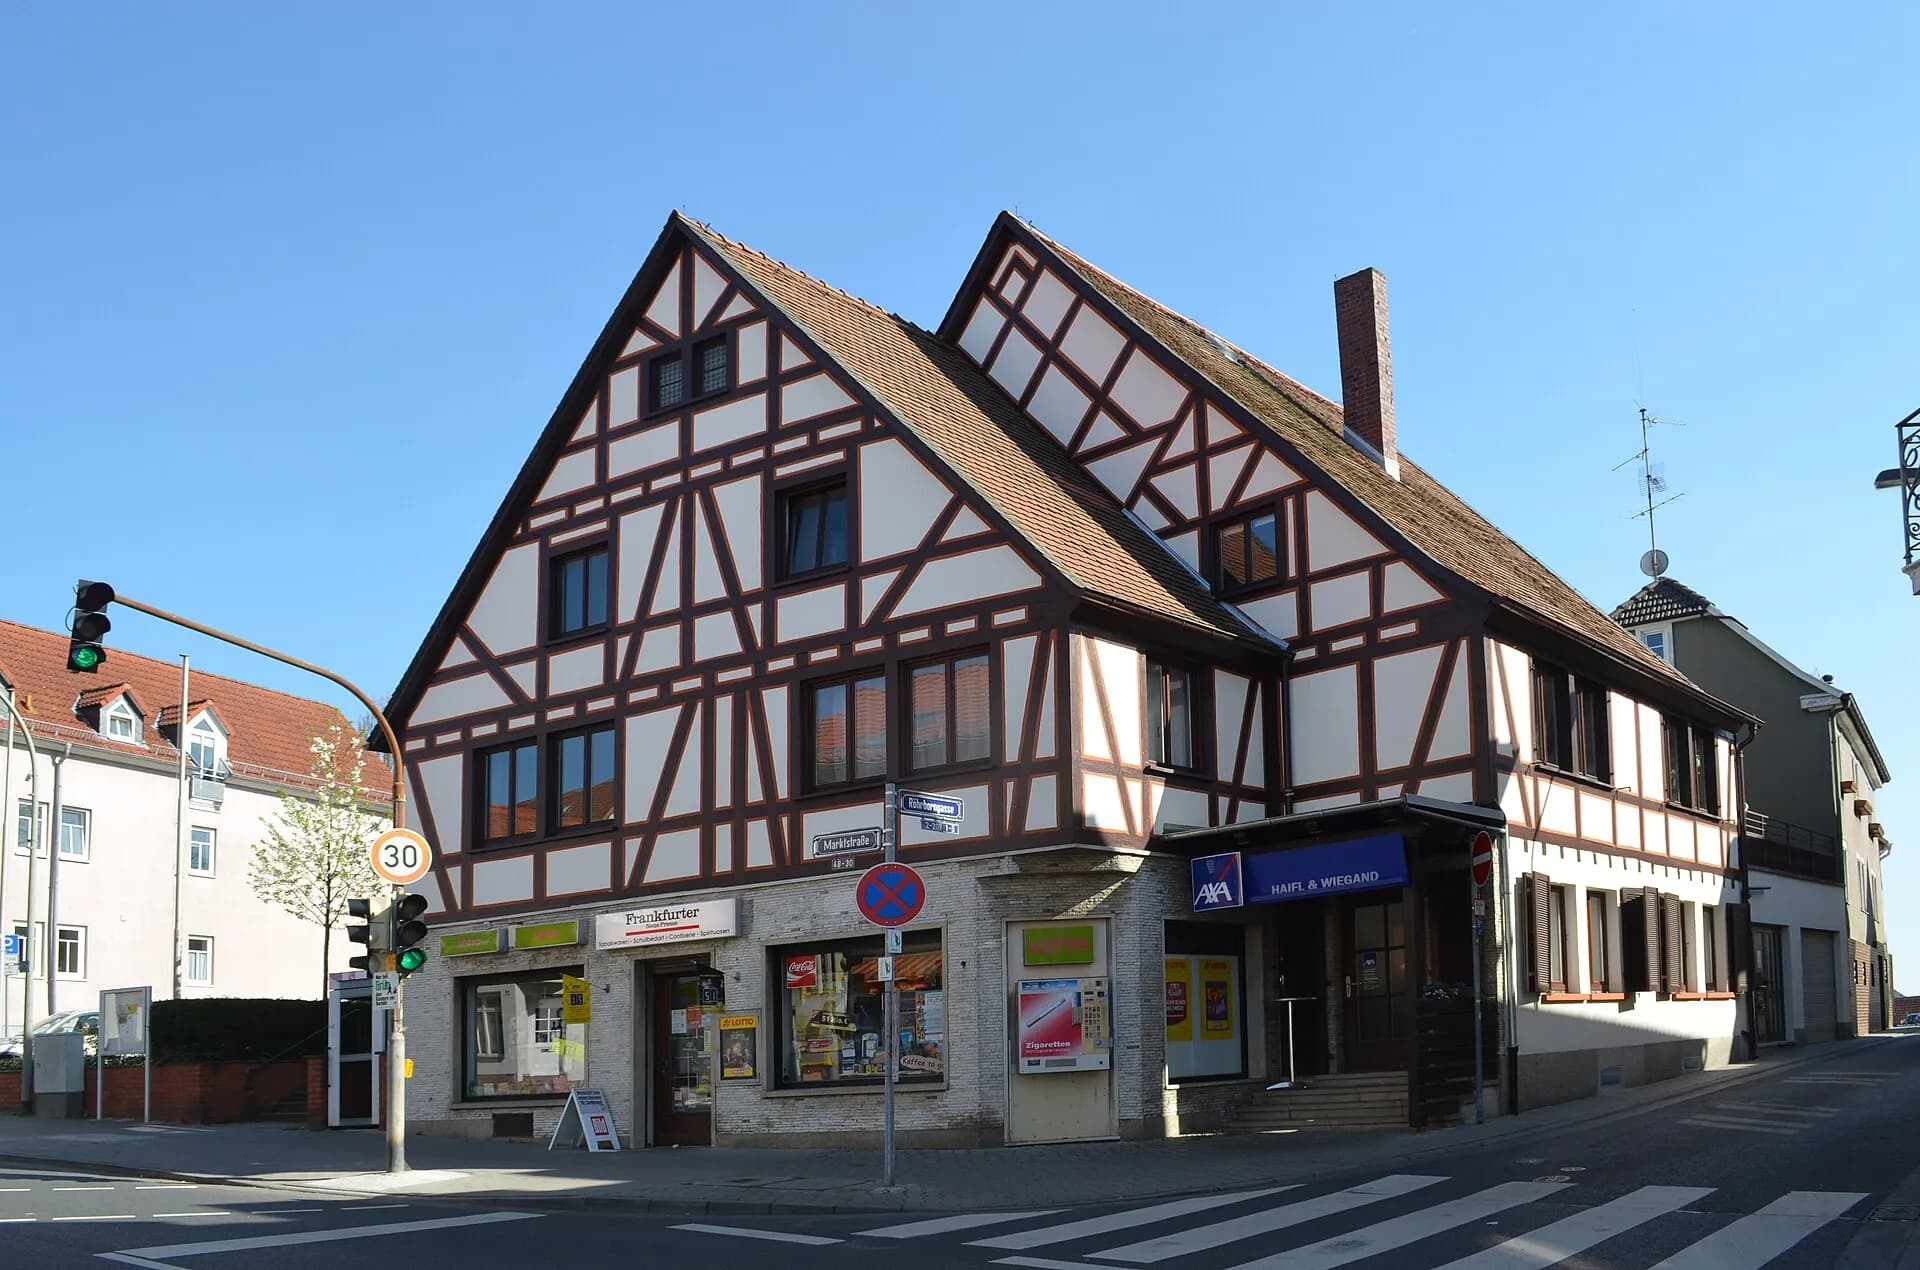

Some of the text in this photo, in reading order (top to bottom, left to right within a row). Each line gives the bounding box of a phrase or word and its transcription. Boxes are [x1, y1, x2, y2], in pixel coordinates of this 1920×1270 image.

[823, 834, 870, 851] Marktstraße
[384, 845, 417, 868] 30
[1271, 871, 1380, 895] HAIFL & WIEGAND
[1194, 881, 1233, 905] AXA
[625, 907, 700, 926] Frankfurter
[731, 1018, 754, 1026] LOTTO
[1025, 1041, 1071, 1050] Zigaretten
[902, 1057, 926, 1066] Kaffee
